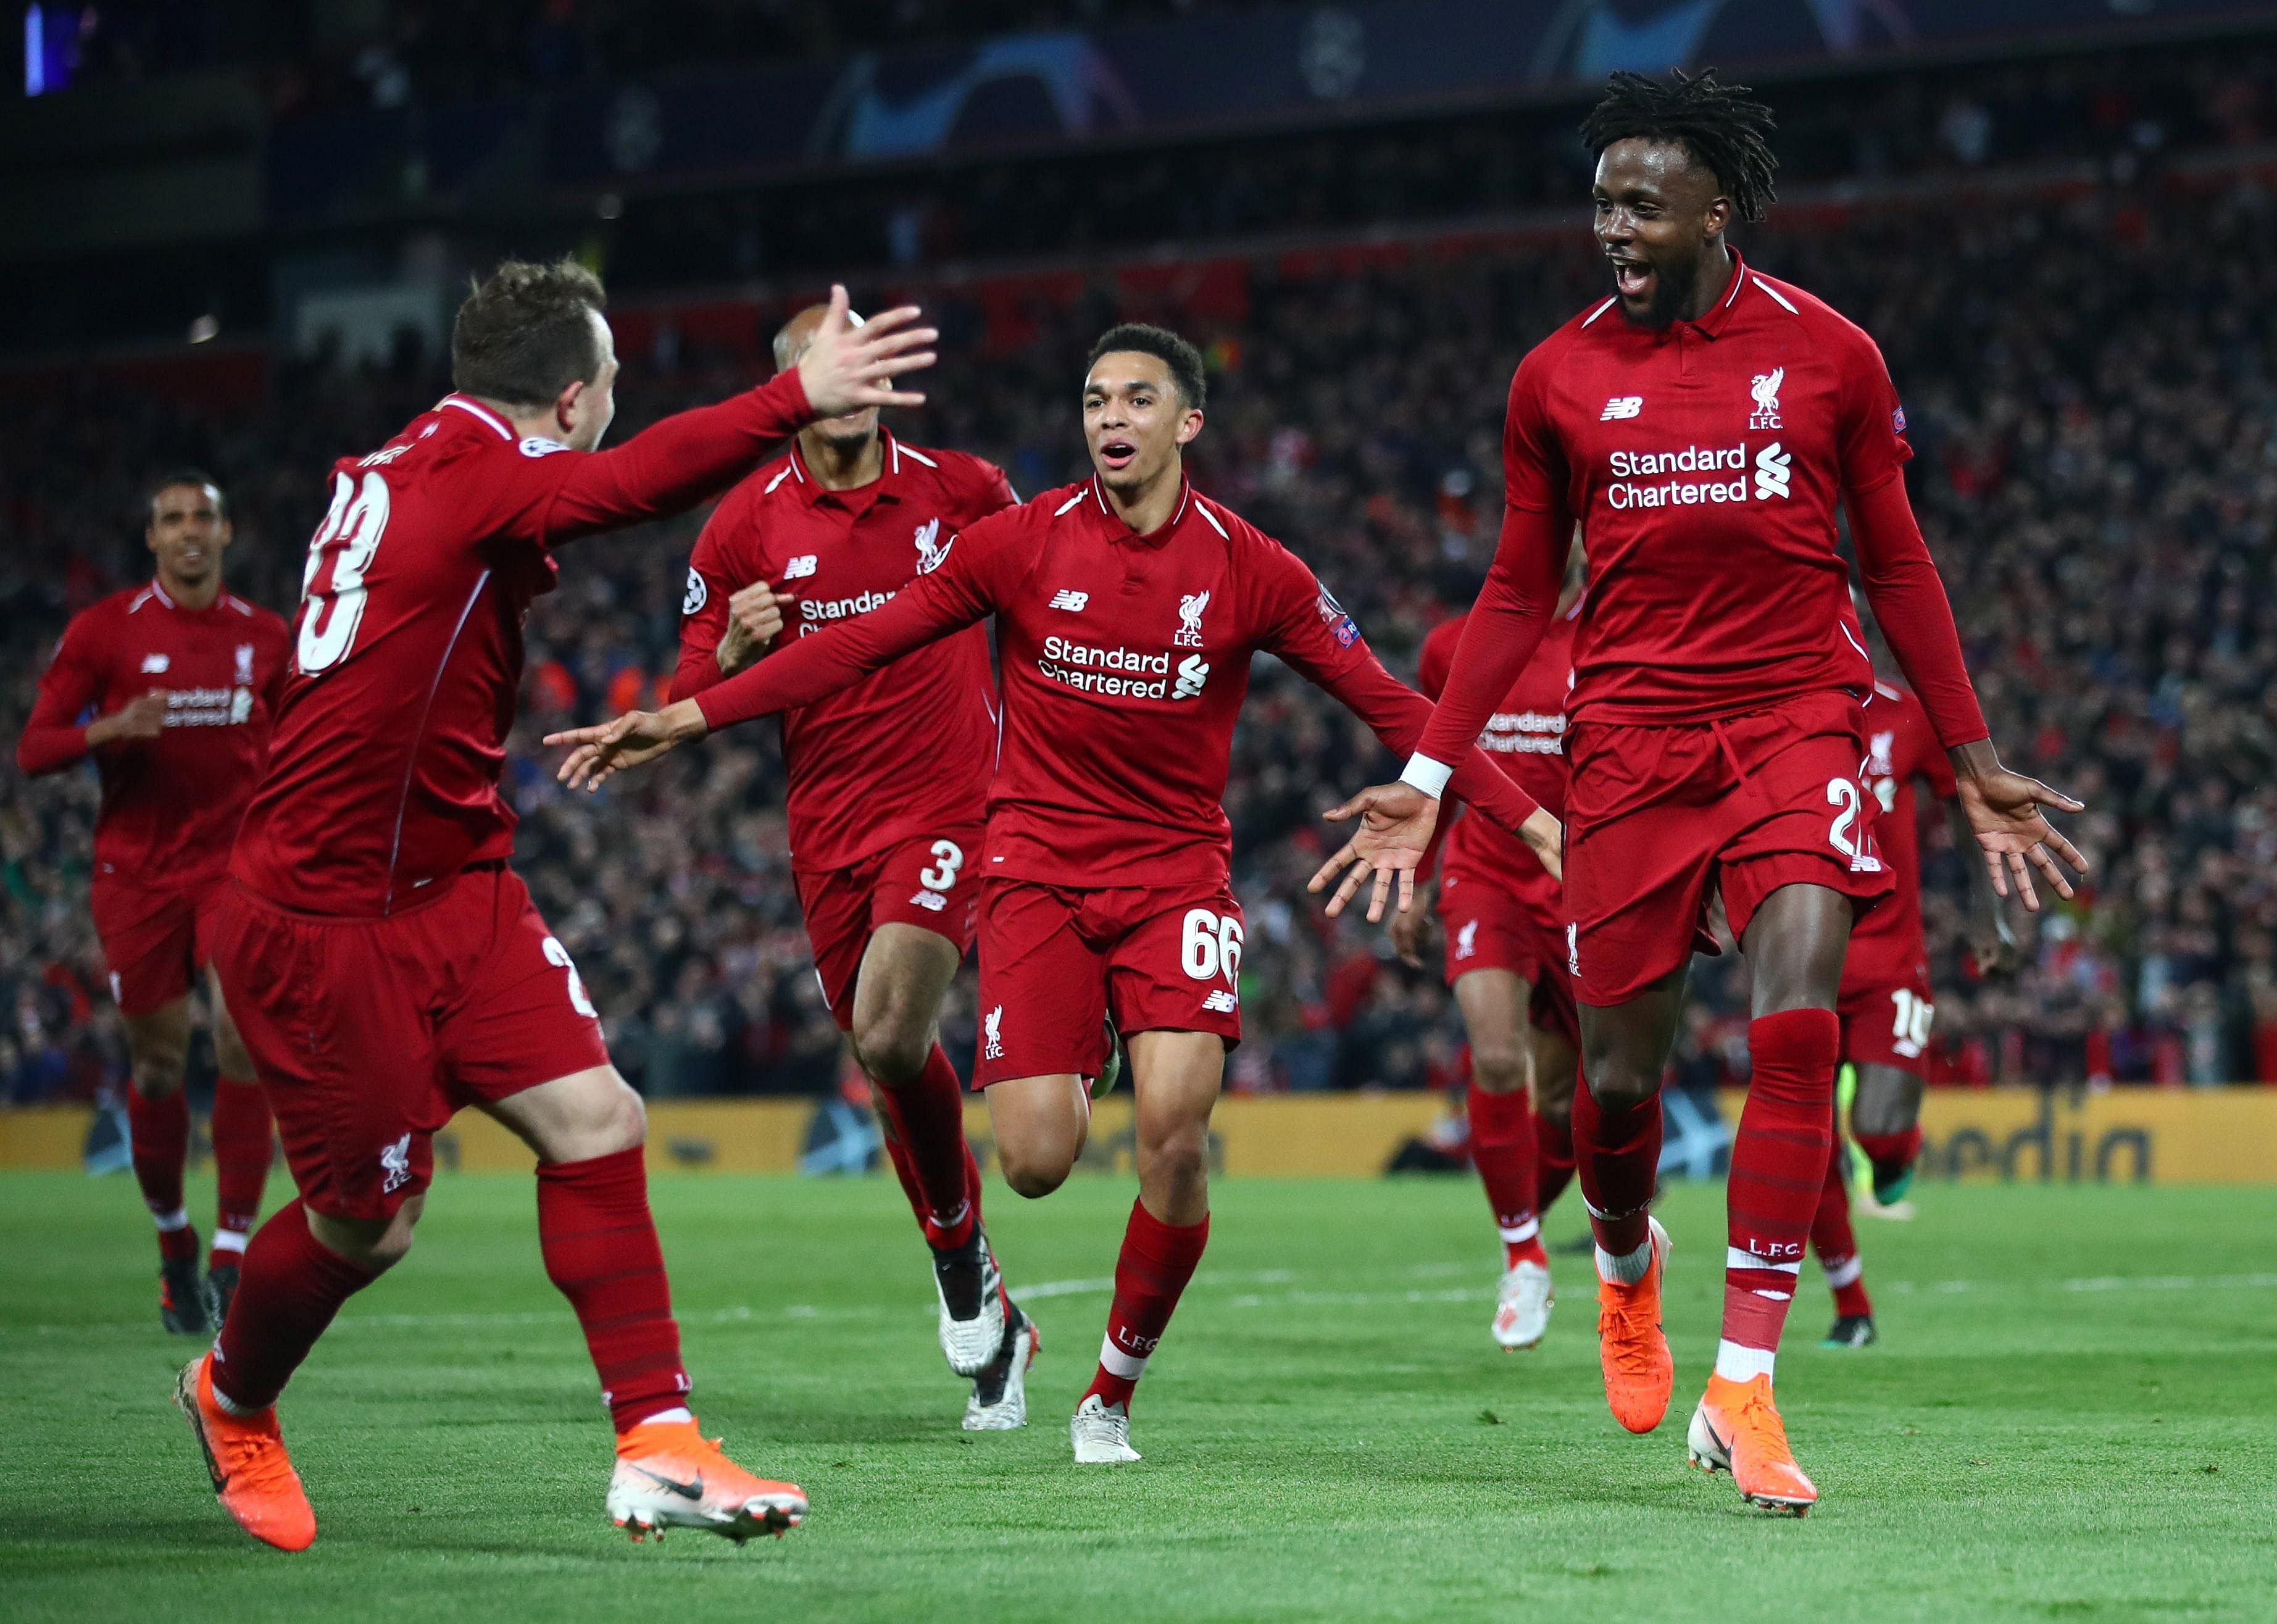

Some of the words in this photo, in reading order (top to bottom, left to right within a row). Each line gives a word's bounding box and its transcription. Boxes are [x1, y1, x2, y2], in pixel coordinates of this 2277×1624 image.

[1749, 416, 1783, 430] L.F.C.
[1609, 443, 1745, 477] Standard
[1608, 475, 1747, 509] Chartered
[800, 589, 897, 620] Standa
[1044, 636, 1170, 674] Standard
[1038, 659, 1167, 699] Chartered
[167, 686, 232, 709] andard
[1826, 778, 1871, 857] 2
[920, 839, 964, 891] 3
[1181, 908, 1245, 986] 66
[1748, 1238, 1800, 1257] L.F.C.
